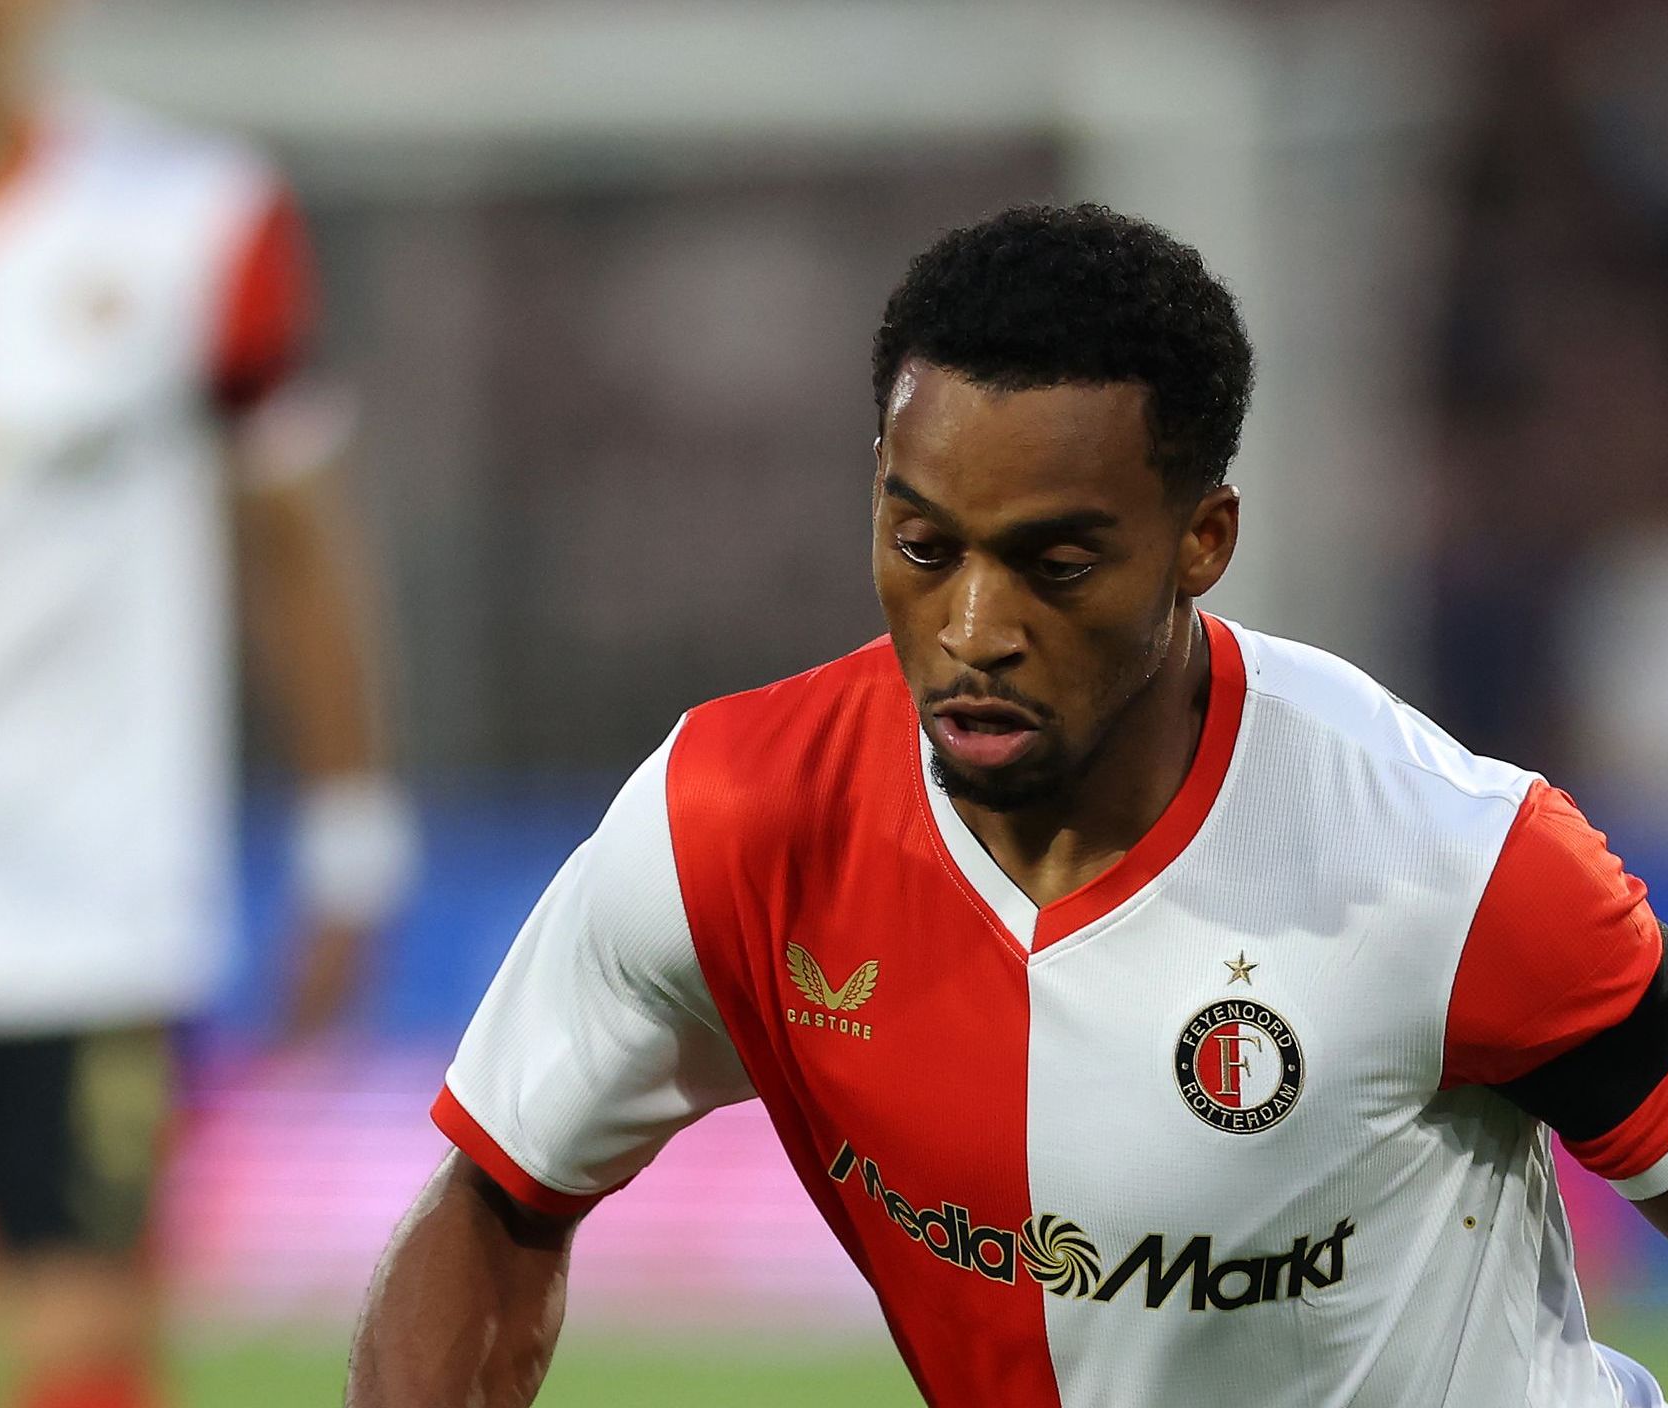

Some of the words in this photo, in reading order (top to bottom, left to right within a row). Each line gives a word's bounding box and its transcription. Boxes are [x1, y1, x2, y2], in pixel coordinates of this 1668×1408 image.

[786, 1008, 872, 1041] CASTORE
[1182, 1003, 1293, 1049] FEYENOORD
[1213, 1034, 1263, 1095] F
[1182, 1081, 1297, 1129] ROTTERDAM
[827, 1138, 1016, 1287] Media
[1089, 1215, 1356, 1313] Markt
